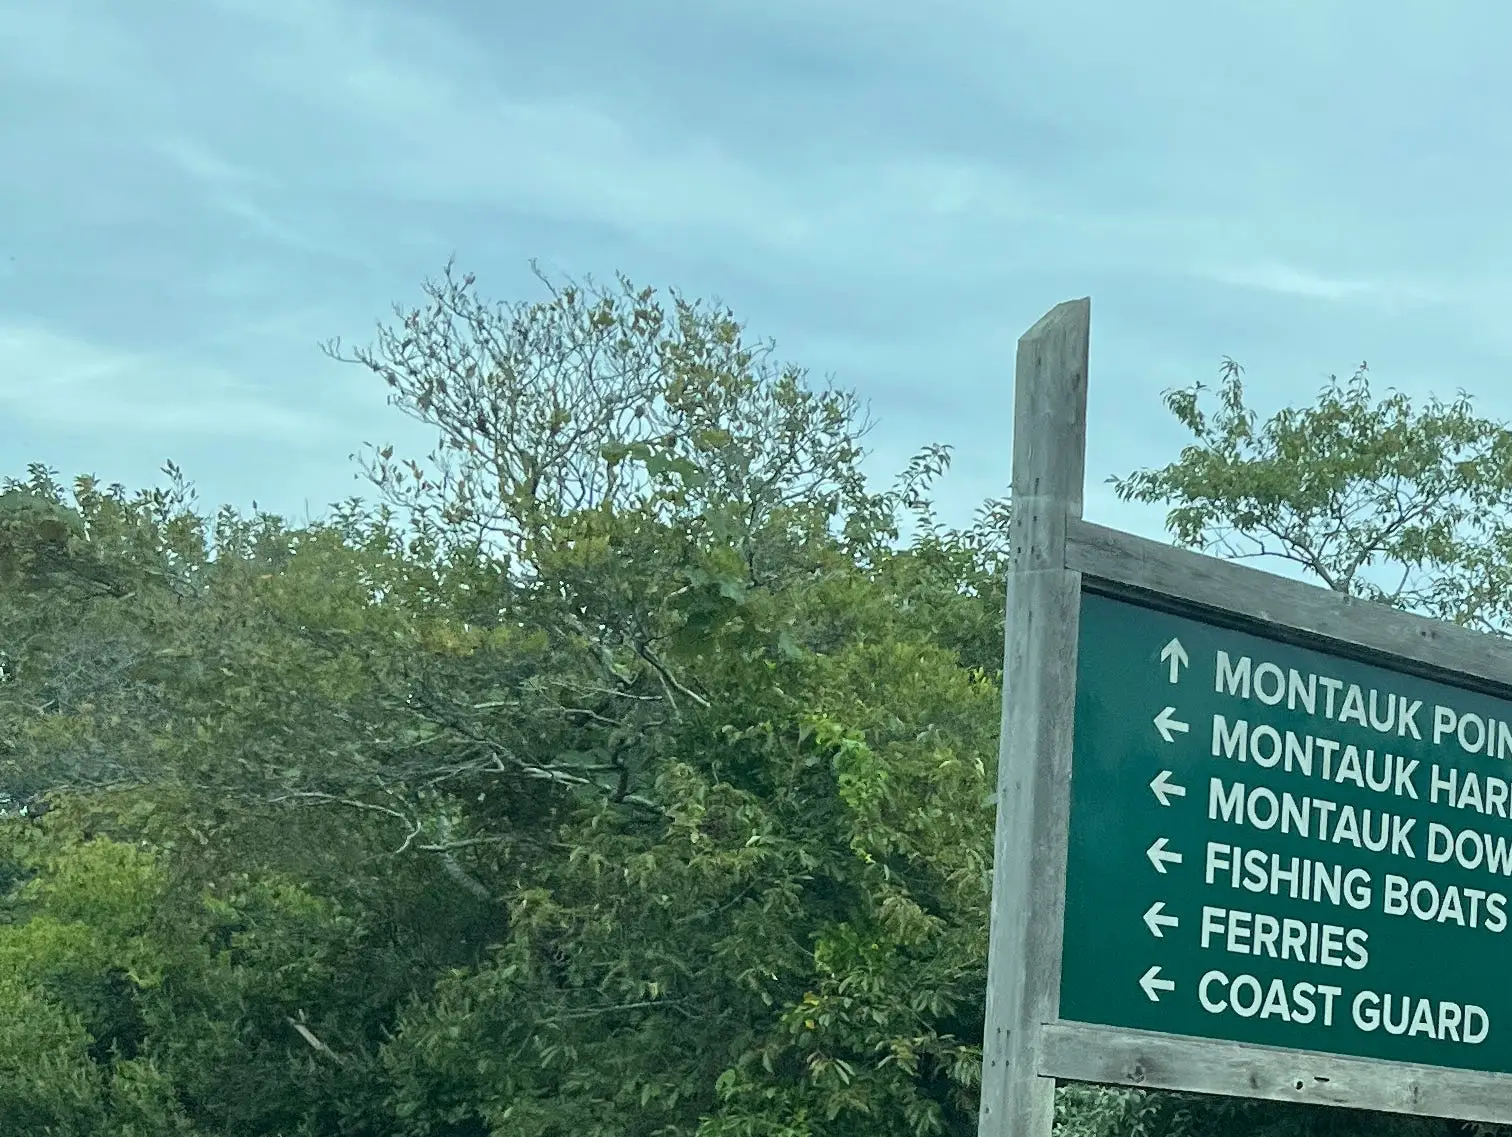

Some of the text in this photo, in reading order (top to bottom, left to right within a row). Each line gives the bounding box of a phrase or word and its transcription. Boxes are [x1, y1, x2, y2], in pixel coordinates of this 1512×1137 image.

[1216, 651, 1422, 739] MONTAUK
[1212, 715, 1419, 799] MONTAUK
[1209, 778, 1416, 858] MONTAUK
[1206, 842, 1507, 932] FISHING BOATS
[1201, 906, 1368, 969] FERRIES
[1199, 971, 1489, 1043] COAST GUARD
